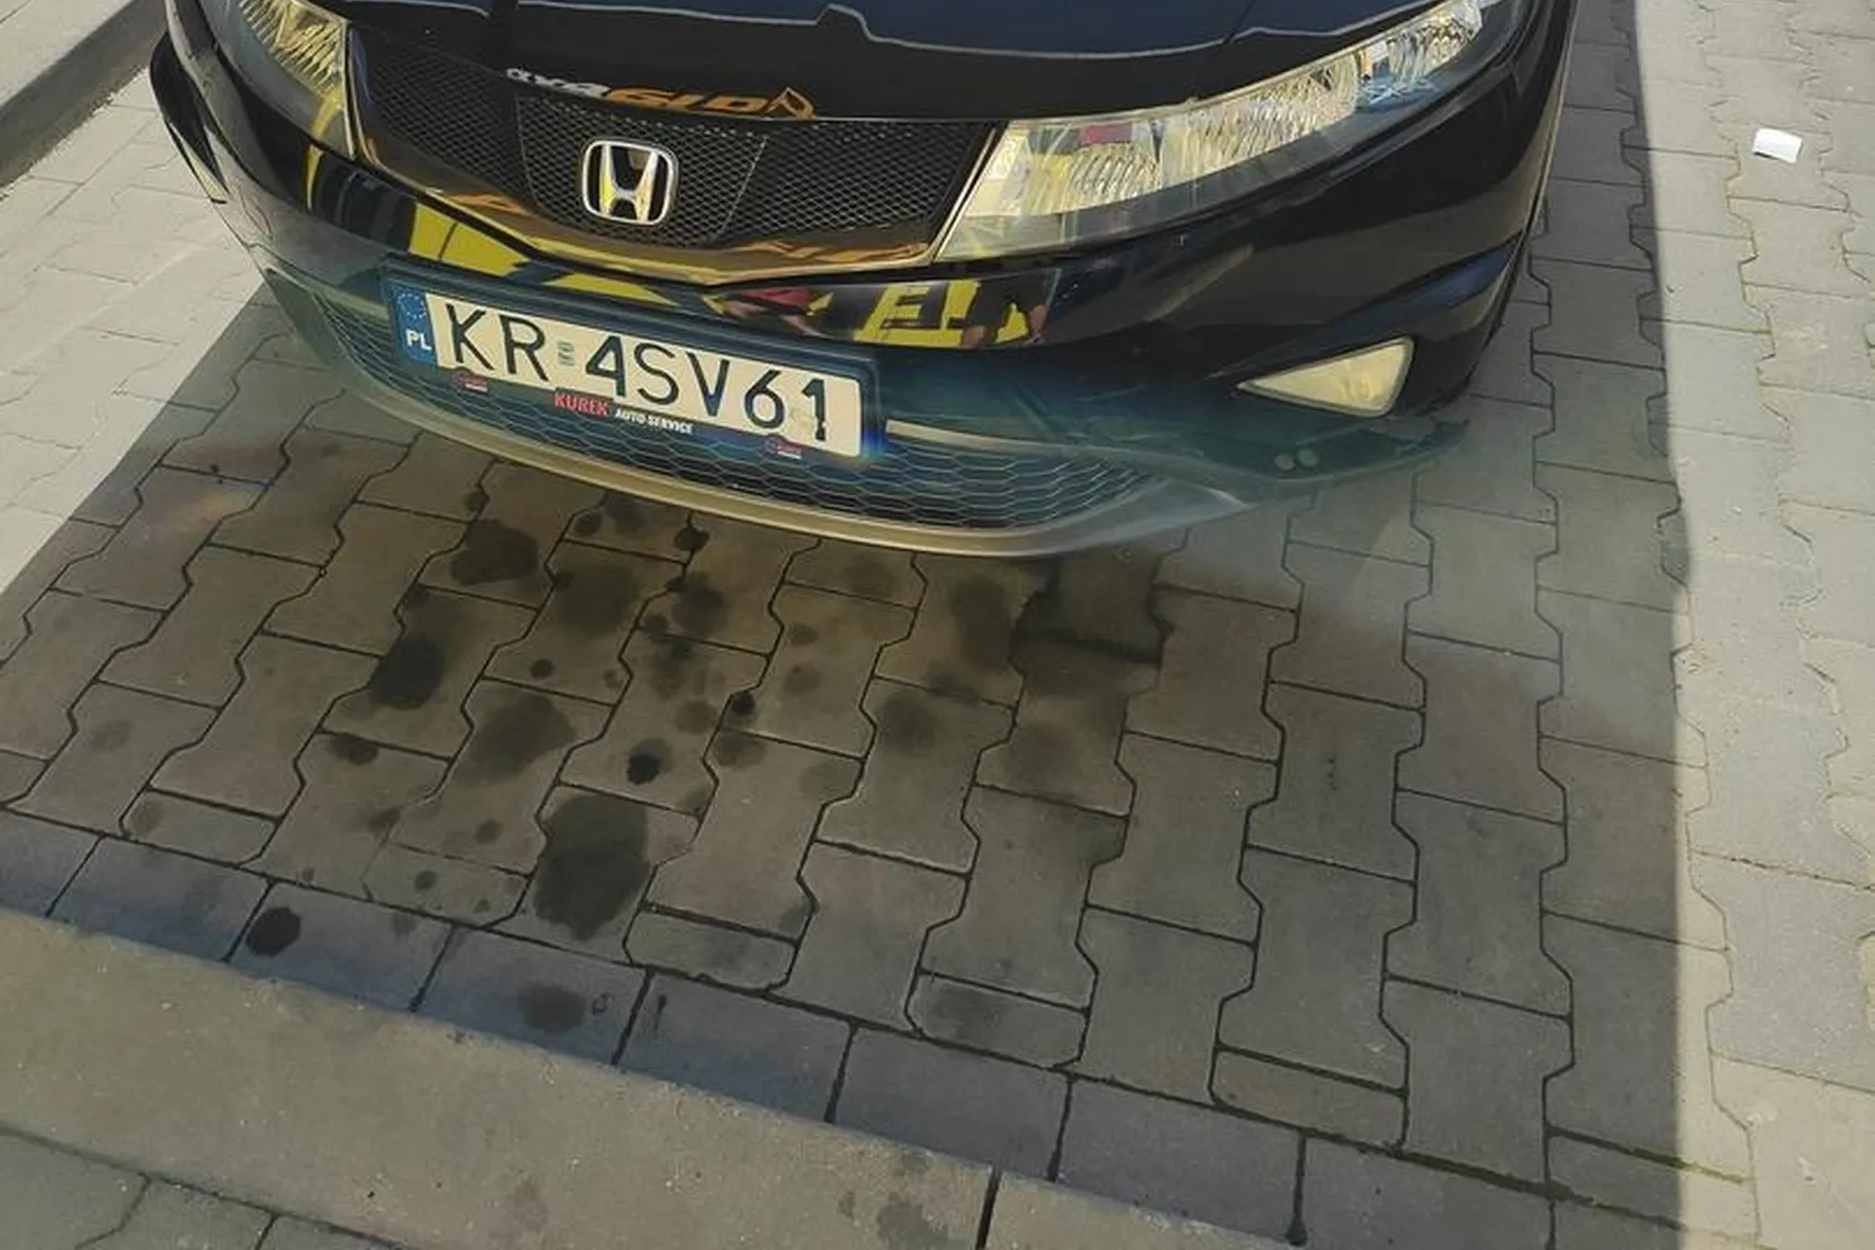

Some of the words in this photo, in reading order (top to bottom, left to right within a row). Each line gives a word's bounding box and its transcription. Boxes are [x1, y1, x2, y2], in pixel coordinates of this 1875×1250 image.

[406, 328, 432, 351] PL
[446, 303, 549, 382] KR
[585, 335, 827, 442] 4SV61
[554, 392, 608, 417] KUREK
[647, 414, 694, 435] SERVICE
